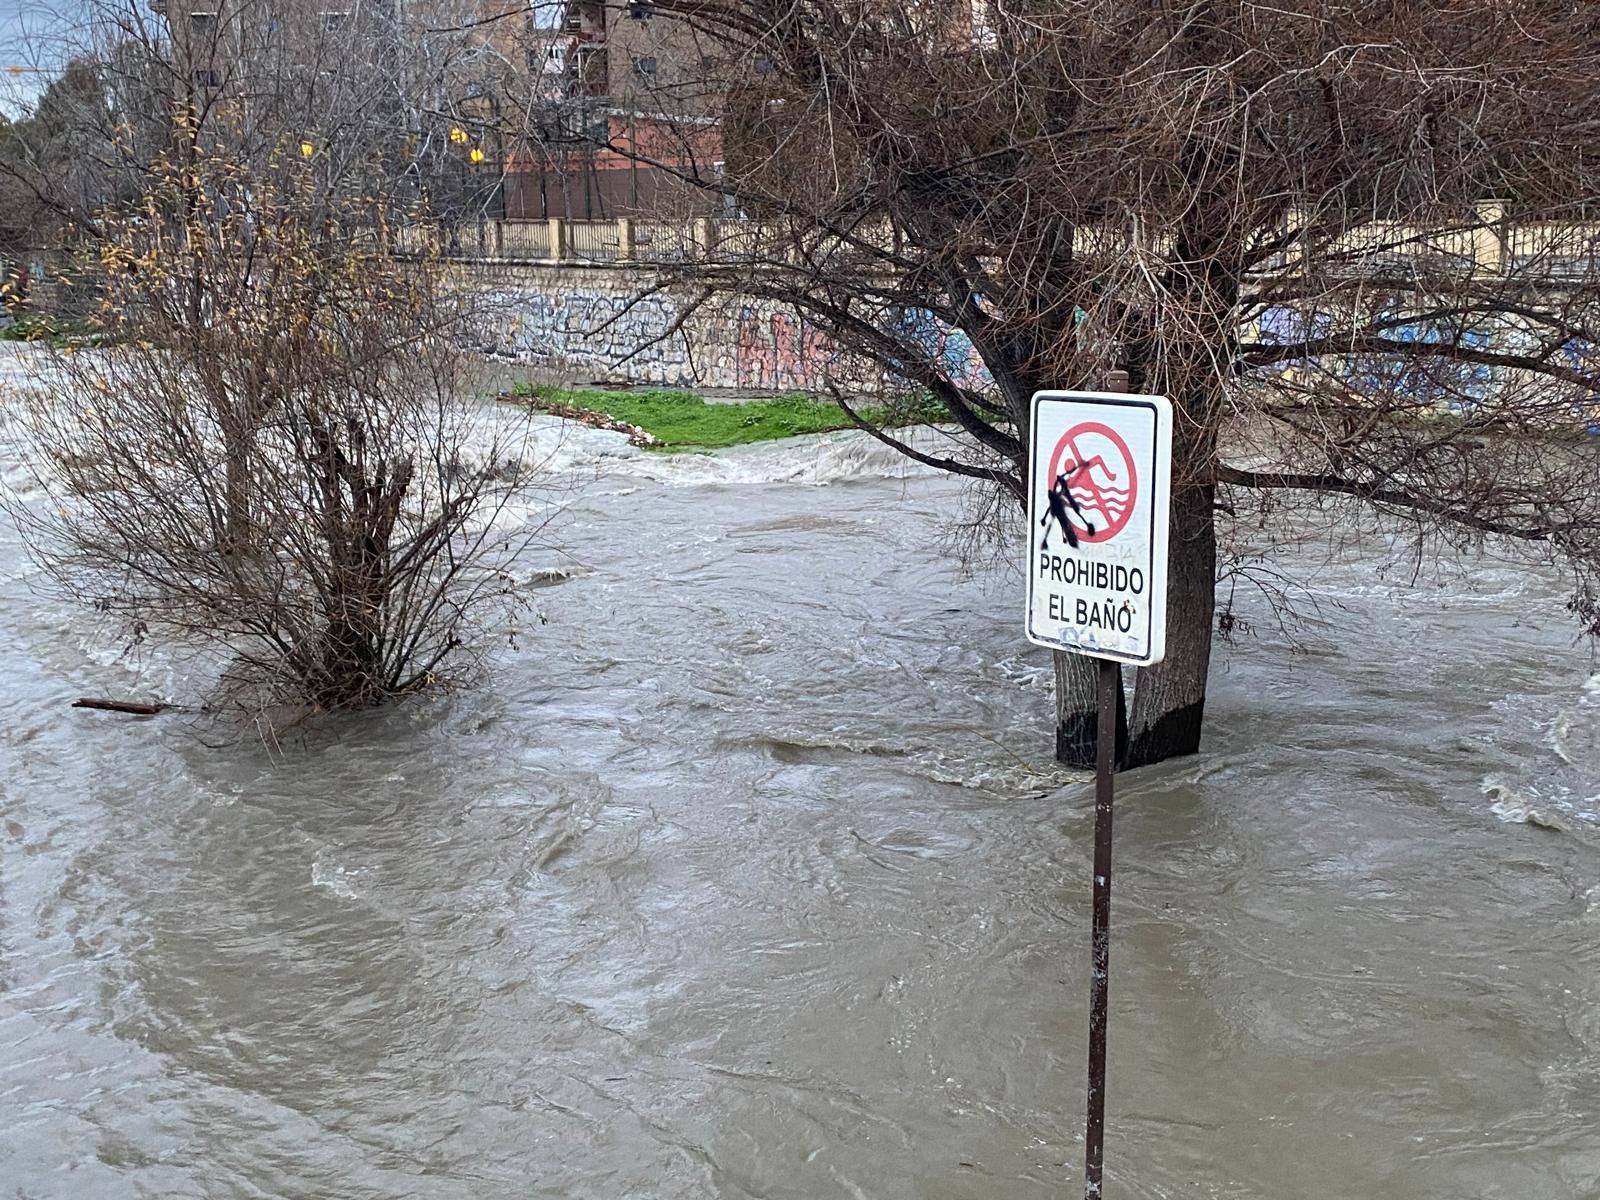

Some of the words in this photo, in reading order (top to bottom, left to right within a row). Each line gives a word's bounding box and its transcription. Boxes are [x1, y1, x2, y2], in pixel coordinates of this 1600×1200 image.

[1040, 553, 1144, 594] PROHIBIDO
[1049, 593, 1070, 623] EL
[1076, 598, 1132, 633] BAÑO
